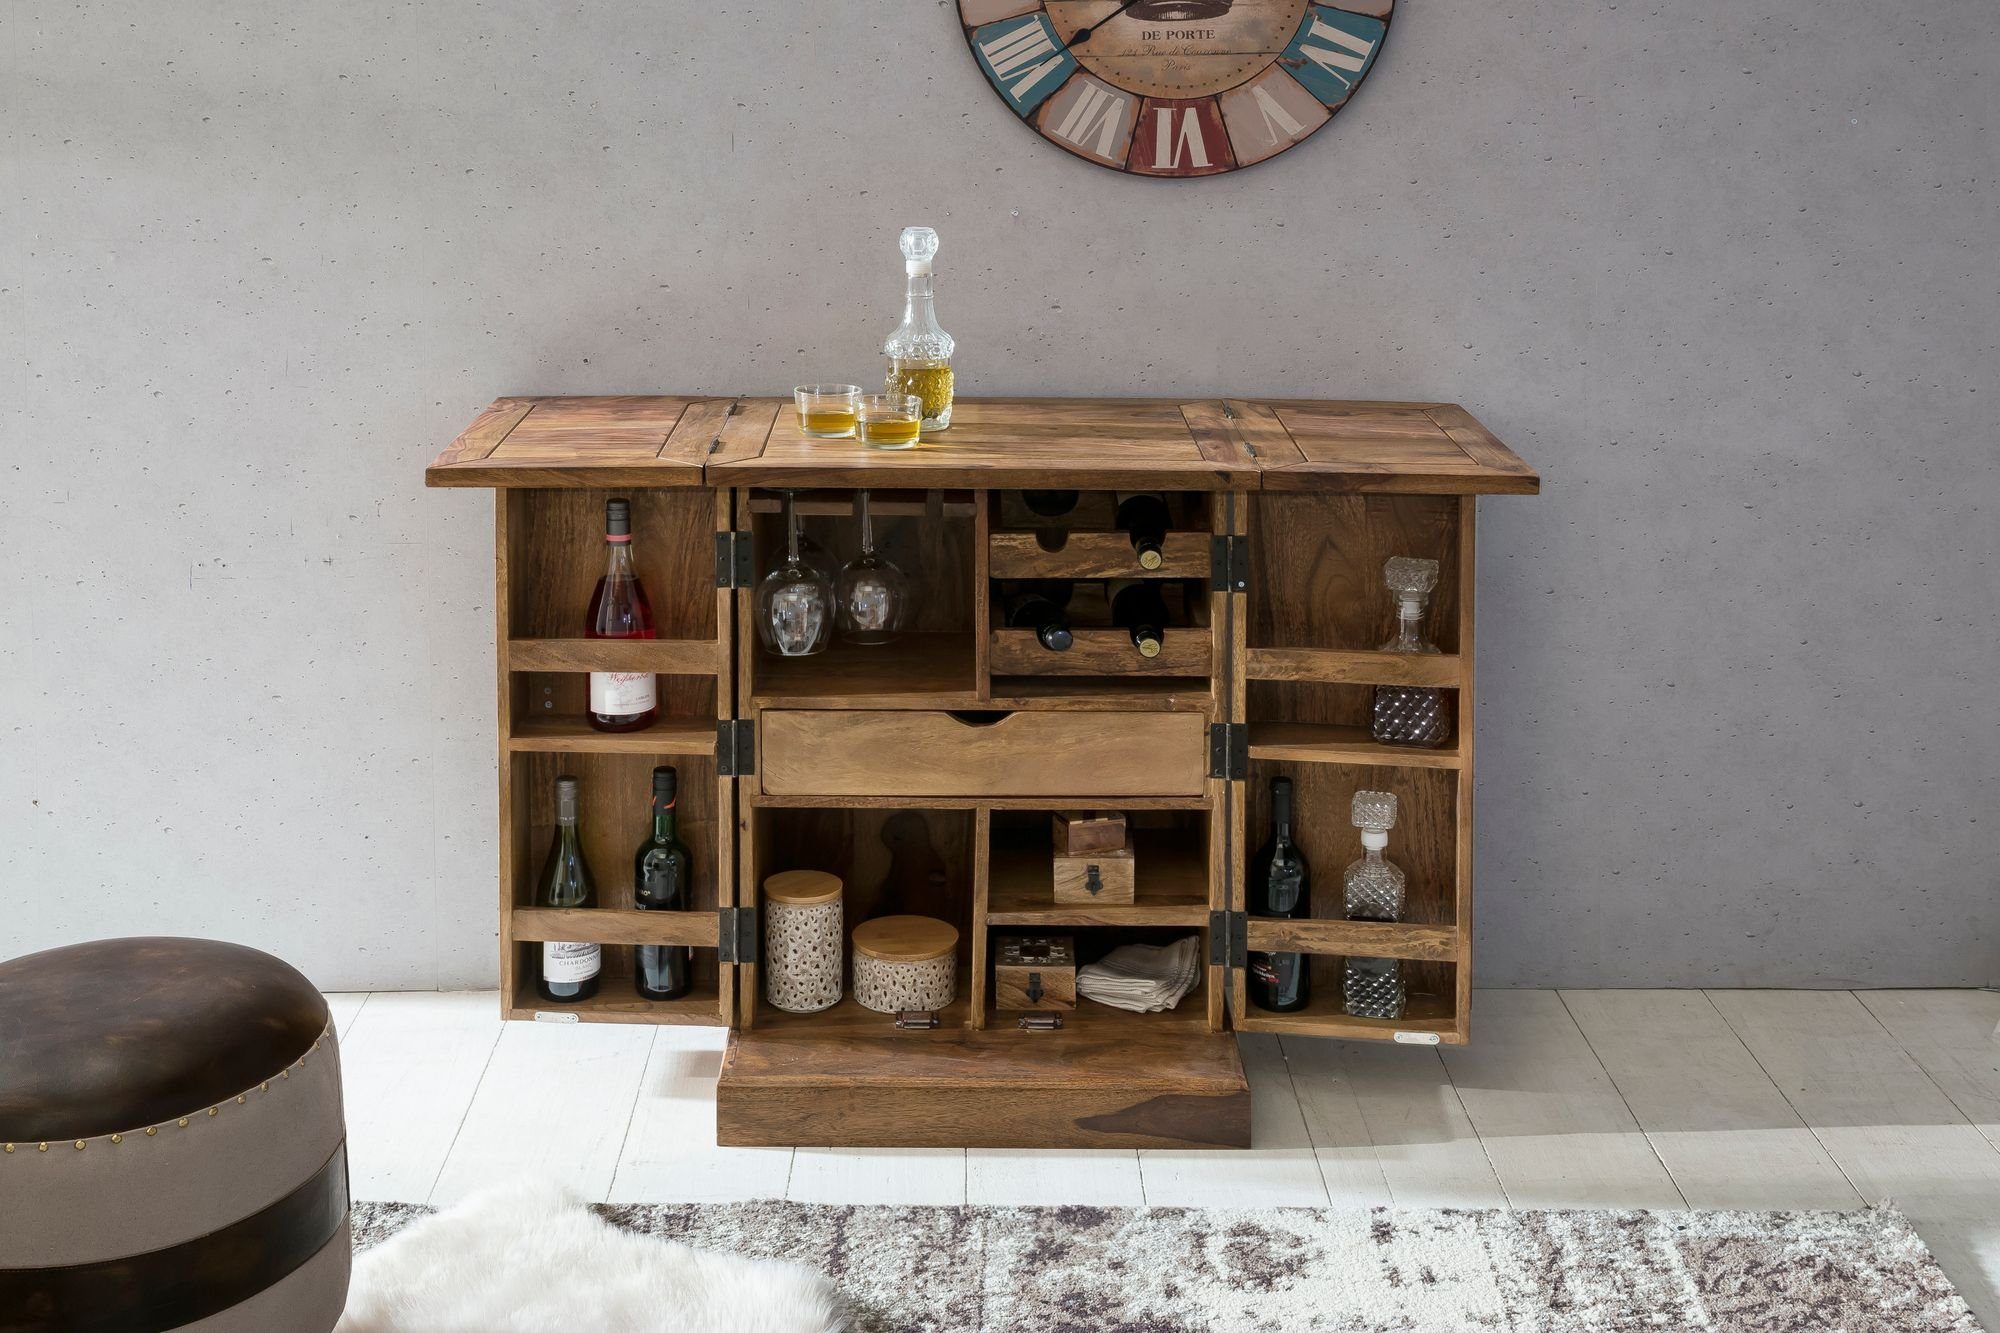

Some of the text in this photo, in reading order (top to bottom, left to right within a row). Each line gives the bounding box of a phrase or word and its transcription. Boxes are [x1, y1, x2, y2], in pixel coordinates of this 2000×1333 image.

[1142, 29, 1216, 41] DE PORTE
[1160, 59, 1192, 72] Paris
[1299, 16, 1376, 90] IV
[1051, 80, 1125, 160] VII
[1151, 107, 1214, 169] VI
[1252, 85, 1307, 146] V
